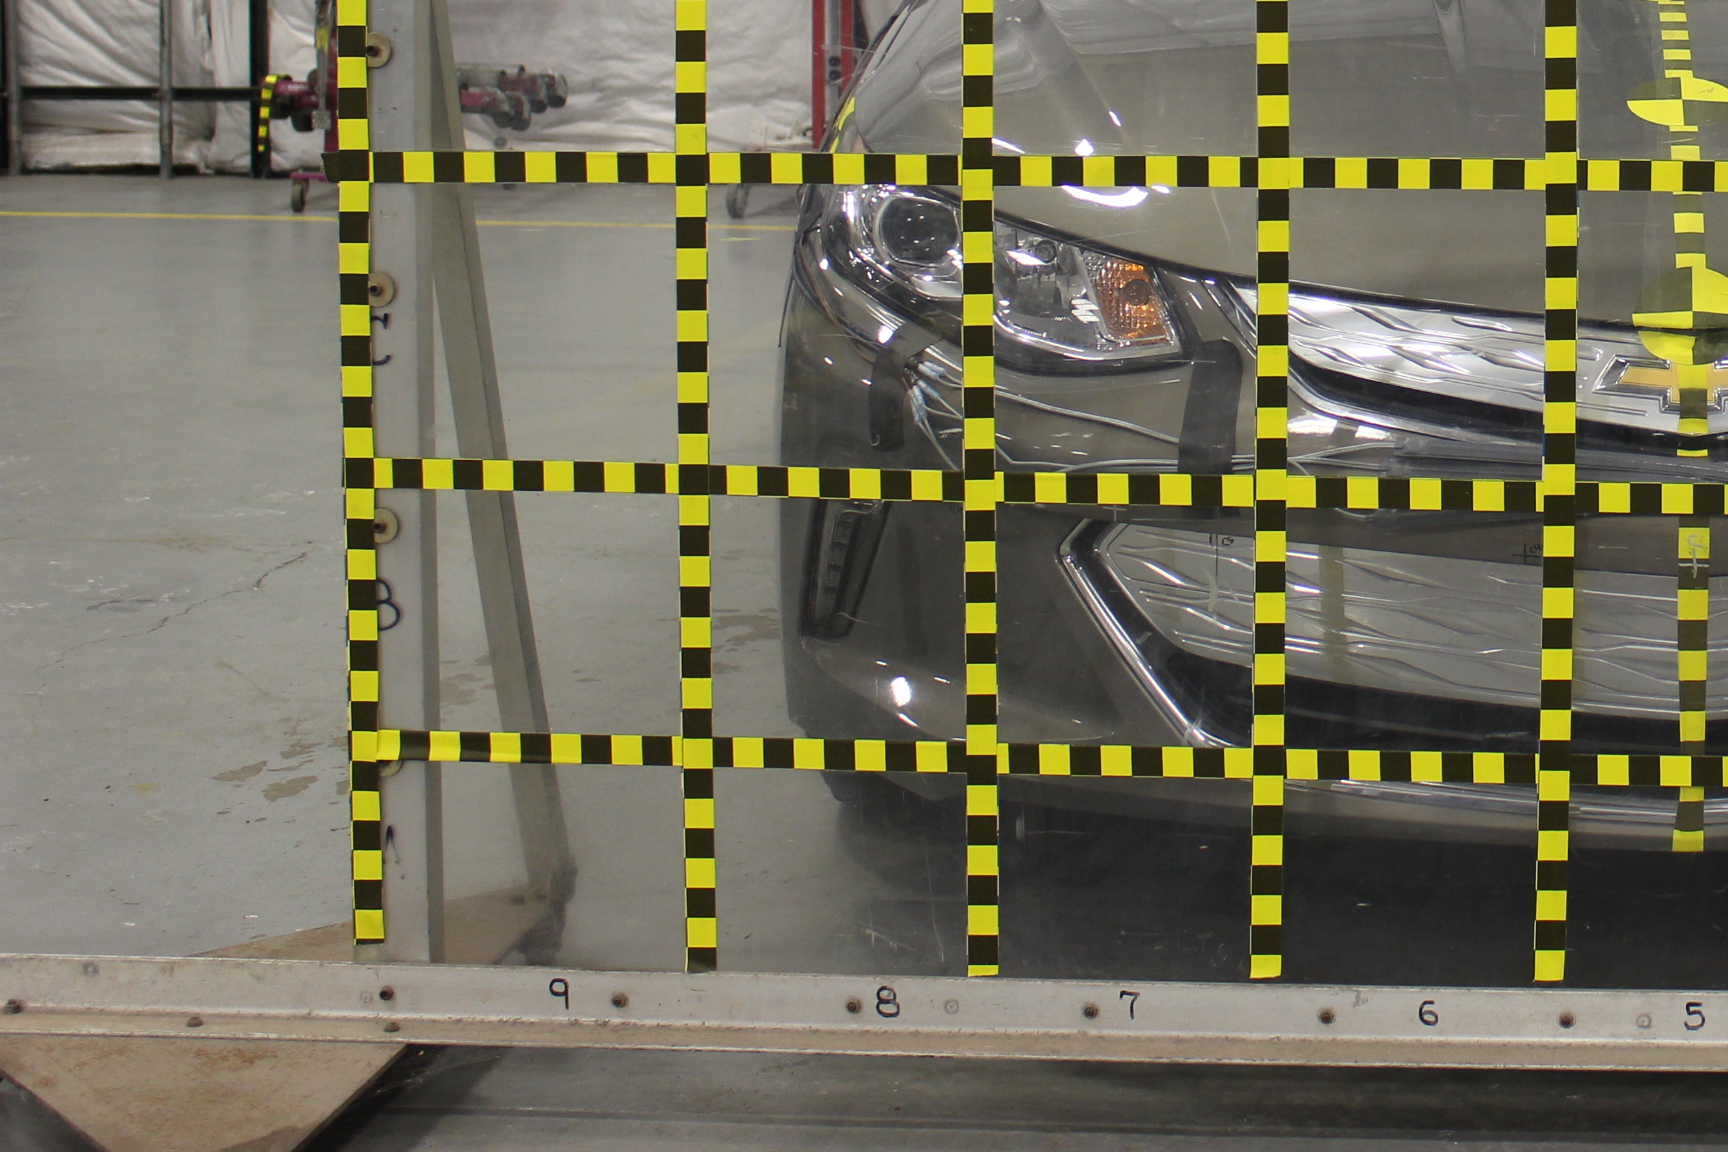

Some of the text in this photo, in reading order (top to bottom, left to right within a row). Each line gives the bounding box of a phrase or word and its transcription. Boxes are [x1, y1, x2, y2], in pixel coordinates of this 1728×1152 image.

[548, 978, 569, 1010] 9
[875, 985, 901, 1019] 8
[1119, 990, 1140, 1020] 7
[1418, 1000, 1439, 1027] 6
[1683, 1001, 1706, 1031] 5
